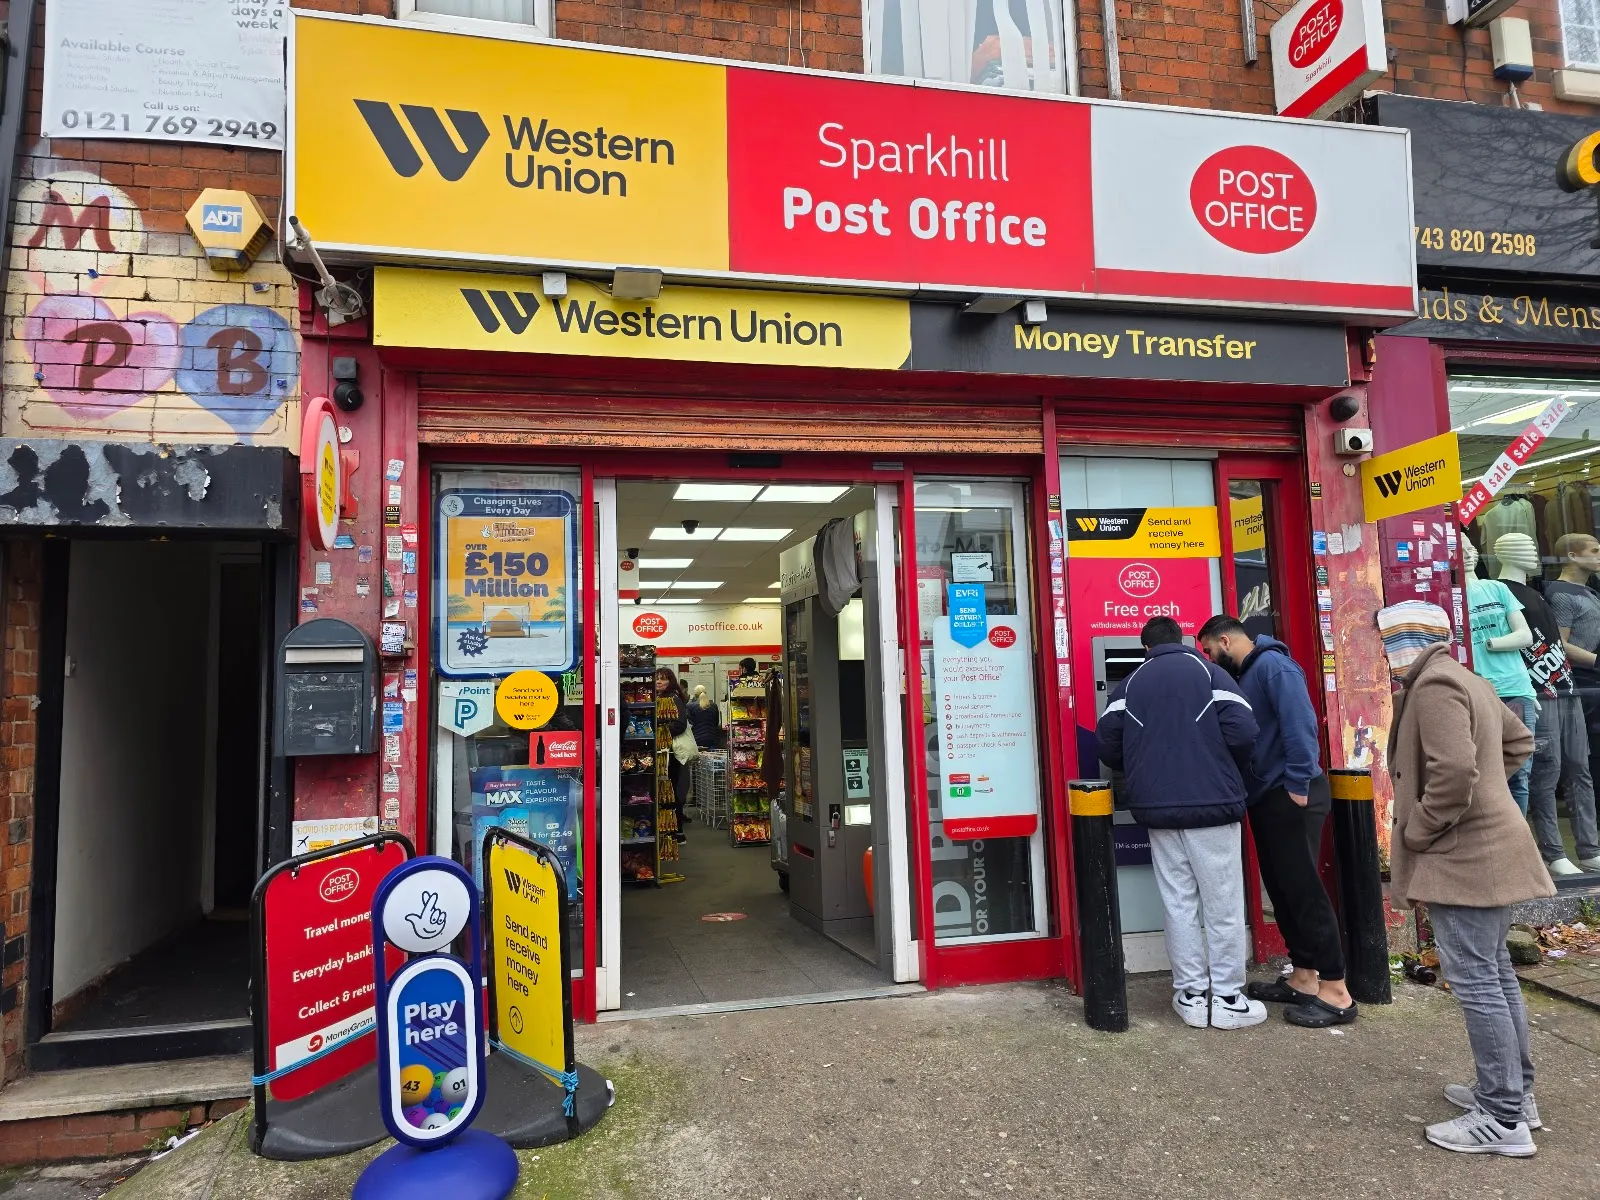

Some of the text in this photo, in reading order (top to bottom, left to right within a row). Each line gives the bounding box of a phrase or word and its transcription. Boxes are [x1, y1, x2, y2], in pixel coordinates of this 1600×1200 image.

[231, 5, 282, 19] days a
[1299, 3, 1330, 40] POST
[236, 18, 279, 30] week
[60, 37, 186, 56] Available Course
[1293, 15, 1338, 62] OFFICE
[201, 70, 228, 80] Airport
[230, 72, 281, 84] Management
[1305, 57, 1332, 82] Sparkhill
[143, 101, 200, 113] Call us on:
[62, 109, 277, 140] 0121 769 2949
[502, 114, 675, 166] Western
[818, 122, 1009, 182] Sparkhill
[505, 152, 627, 197] Union
[1219, 169, 1294, 200] POST
[203, 208, 242, 227] ADT
[783, 186, 1047, 247] Post Office
[1205, 201, 1304, 232] OFFICE
[1413, 226, 1536, 257] 743 820 2598
[1421, 286, 1600, 330] ids & Mens
[552, 298, 842, 347] Western Union
[1014, 324, 1257, 360] Money Transfer
[1541, 402, 1565, 429] sale
[1513, 430, 1540, 459] sale
[1403, 457, 1446, 479] Western
[1488, 461, 1512, 488] sale
[1405, 476, 1435, 492] Union
[473, 497, 542, 506] Changing Lives
[485, 506, 531, 516] Every Day
[1460, 490, 1486, 518] sale
[1099, 517, 1129, 525] Western
[1100, 524, 1121, 532] Union
[1147, 517, 1191, 526] Send and
[1148, 529, 1184, 538] receive
[1149, 540, 1205, 550] money here
[464, 552, 549, 577] £150
[1123, 580, 1155, 588] OFFICE
[1128, 571, 1151, 580] POST
[464, 578, 549, 597] Million
[1104, 600, 1180, 617] Free cash
[635, 625, 664, 633] OFFICE
[640, 617, 661, 626] POST
[688, 621, 763, 633] postoffice.co.uk
[1090, 621, 1132, 629] withdrawals
[942, 656, 978, 665] everything
[960, 674, 977, 682] Post
[979, 673, 1000, 681] Office
[486, 790, 523, 806] MAX
[525, 787, 557, 795] FLAVOUR
[525, 795, 567, 804] EXPERIENCE
[537, 830, 573, 839] for £2.49
[324, 880, 354, 896] OFFICE
[329, 873, 351, 887] POST
[521, 876, 547, 898] Western
[973, 856, 988, 907] YOUR
[522, 887, 540, 905] Union
[303, 918, 339, 940] Travel
[505, 914, 548, 951] Send and
[505, 936, 541, 966] receive
[292, 957, 345, 983] Everyday
[506, 955, 539, 986] money
[507, 972, 529, 997] here
[298, 990, 350, 1019] Collect &
[404, 1000, 457, 1025] Play
[325, 1016, 373, 1043] MoneyGram
[405, 1021, 458, 1046] here
[403, 1079, 467, 1092] 43 01
